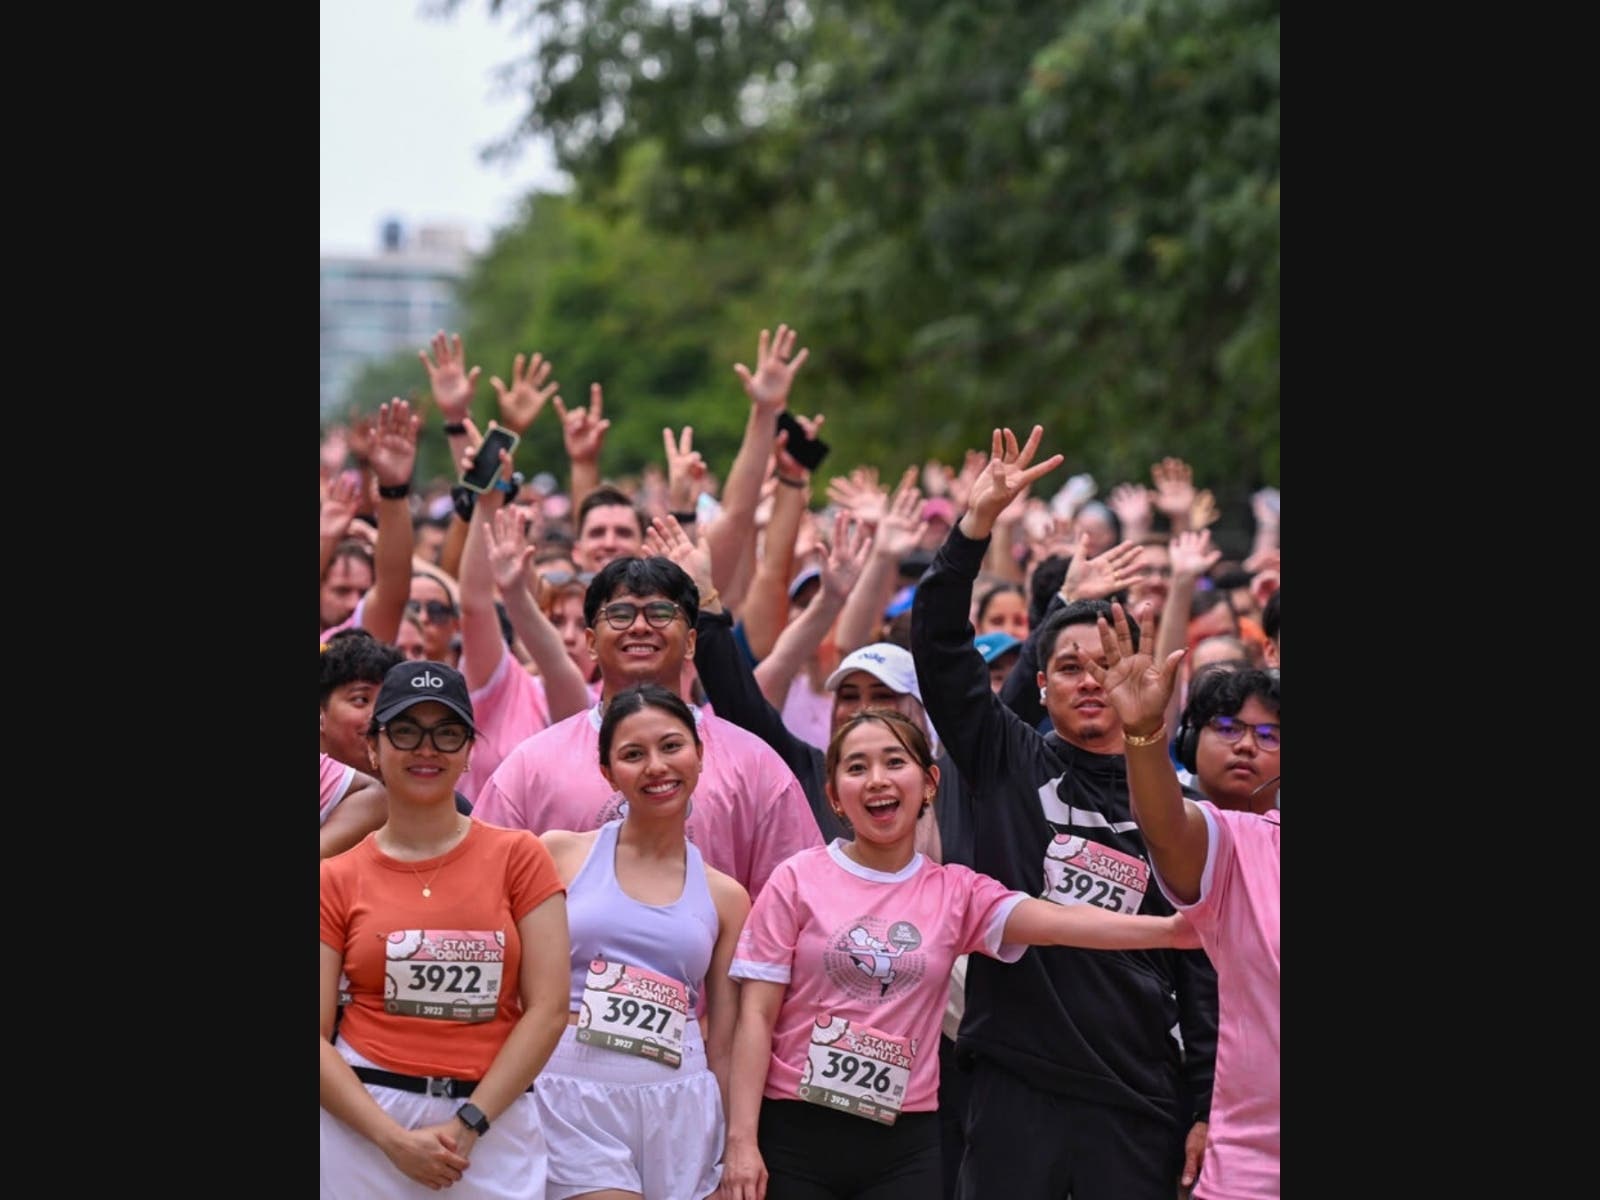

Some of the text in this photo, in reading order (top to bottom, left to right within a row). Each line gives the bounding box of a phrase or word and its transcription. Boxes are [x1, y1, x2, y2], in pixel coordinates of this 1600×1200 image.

[410, 670, 444, 688] alo
[1090, 863, 1130, 884] DONUT
[1099, 856, 1137, 877] STAN'S
[1056, 867, 1126, 912] 3925
[443, 940, 485, 950] STAN'S
[436, 950, 501, 962] DONUT 5K
[408, 964, 481, 993] 3922
[640, 979, 677, 998] STAN'S
[632, 986, 673, 1006] DONUT
[423, 1005, 444, 1016] 3922
[602, 996, 672, 1034] 3927
[613, 1038, 634, 1049] 3927
[855, 1043, 895, 1062] DONUT
[863, 1035, 902, 1055] STAN'S
[821, 1051, 890, 1093] 3926
